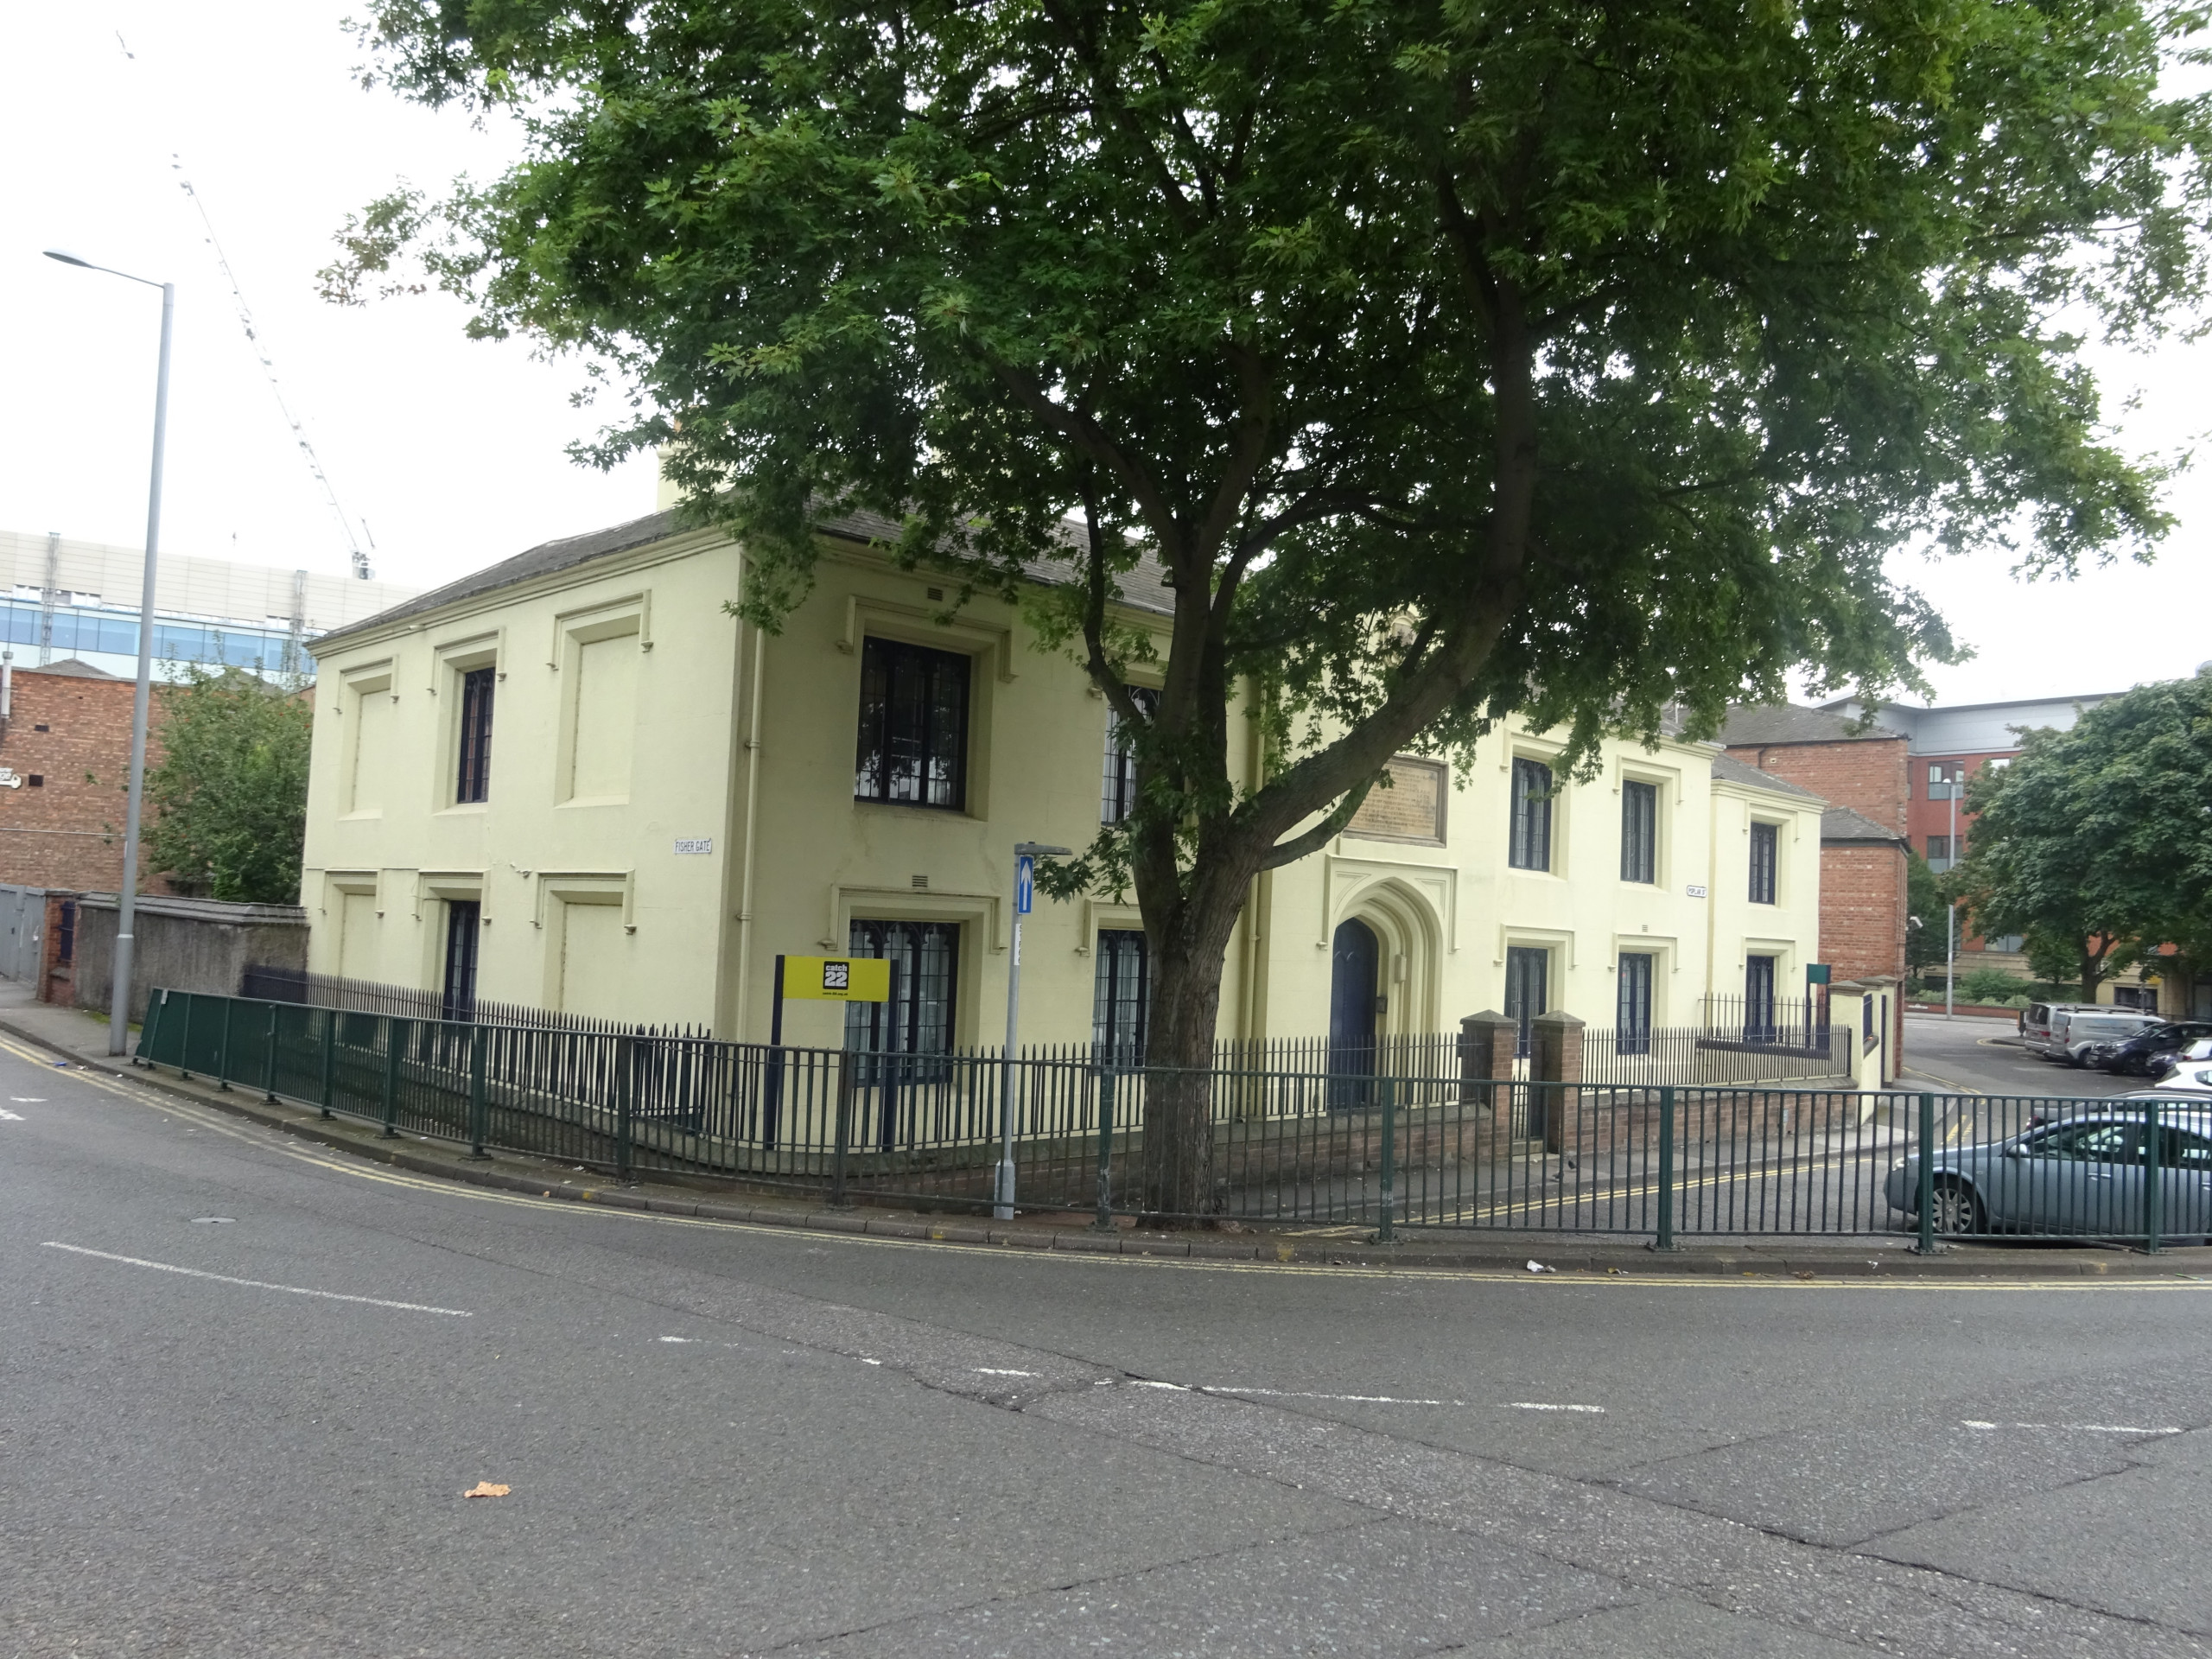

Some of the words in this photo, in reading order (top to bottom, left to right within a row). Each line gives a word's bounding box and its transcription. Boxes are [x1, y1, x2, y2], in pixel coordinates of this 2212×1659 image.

[675, 841, 694, 852] FISHER
[696, 840, 709, 851] GATE
[824, 971, 848, 987] 22
